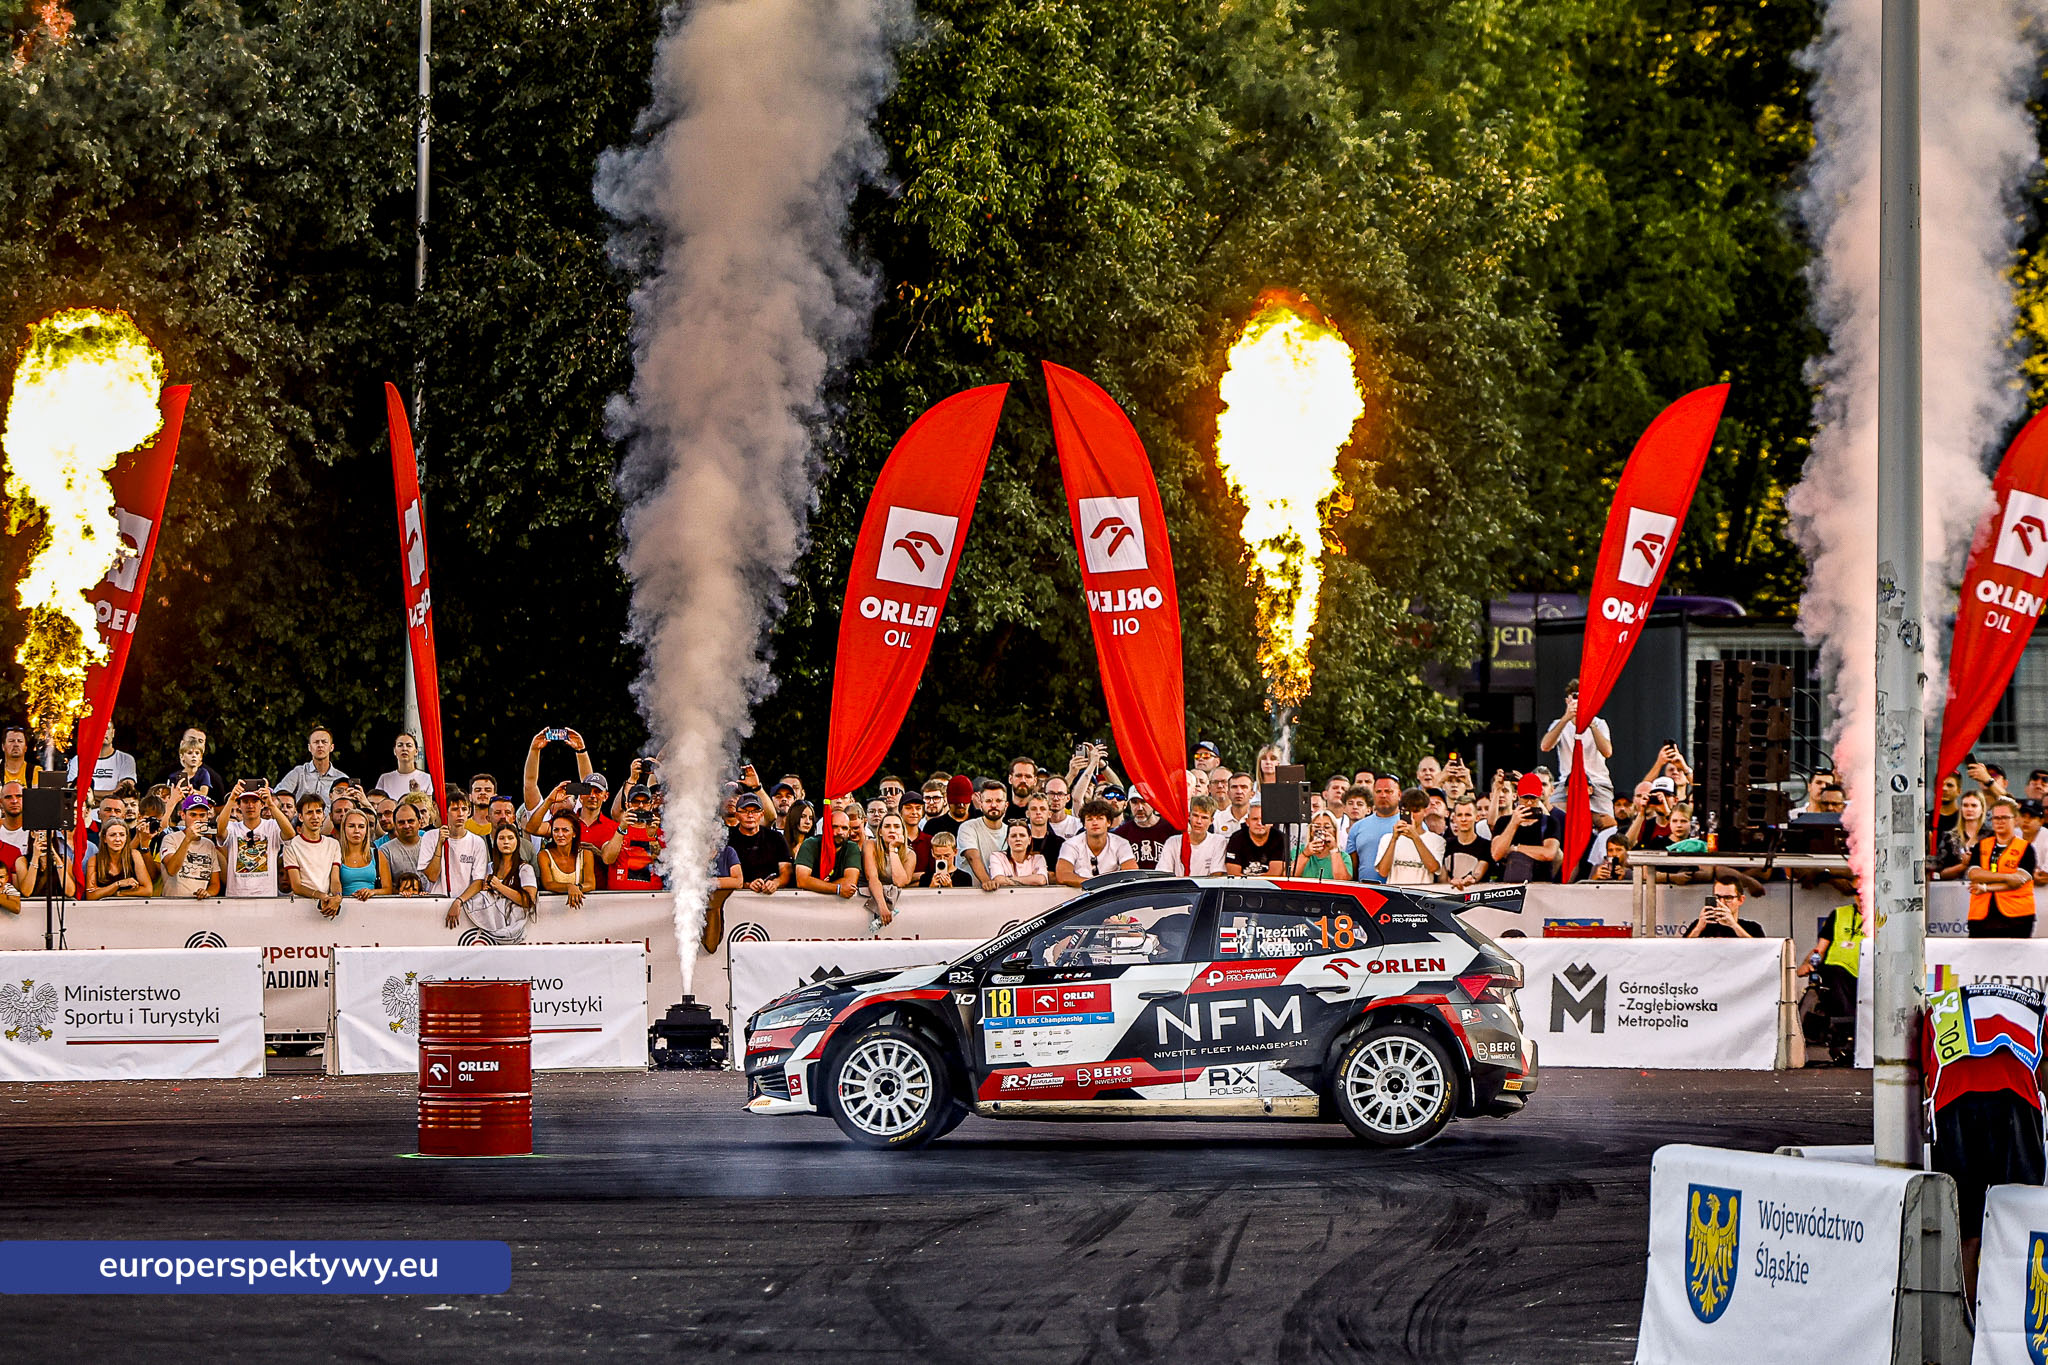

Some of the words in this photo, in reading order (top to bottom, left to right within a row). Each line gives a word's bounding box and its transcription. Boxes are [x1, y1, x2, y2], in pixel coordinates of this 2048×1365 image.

[1976, 579, 2043, 618] ORLEN
[860, 596, 938, 628] ORLEN
[1984, 611, 2011, 633] OIL
[884, 629, 912, 648] OIL
[1484, 889, 1522, 899] SKODA
[984, 918, 1046, 957] rzeznikadrian
[1239, 929, 1251, 938] A.
[1256, 925, 1308, 938] Rzeźnik
[1314, 915, 1355, 949] 18
[1239, 942, 1253, 953] K.
[1257, 939, 1313, 953] Kozdroń
[1367, 958, 1446, 975] ORLEN
[1226, 972, 1278, 982] PRO-FAMILIA
[64, 985, 181, 1002] Ministerstwo
[1063, 991, 1095, 1000] ORLEN
[1619, 981, 1699, 998] Górnośląsko
[531, 996, 603, 1014] urystyki
[988, 989, 1012, 1018] 18
[1619, 998, 1718, 1014] -Zagłębiowska
[64, 1009, 123, 1028] Sportu
[129, 1008, 133, 1024] i
[139, 1007, 220, 1027] Turystyki
[1040, 1016, 1083, 1024] Championship
[1156, 995, 1303, 1045] NFM
[1618, 1014, 1689, 1031] Metropolia
[1154, 1049, 1197, 1059] NIVETTE
[1200, 1046, 1232, 1055] FLEET
[1236, 1039, 1309, 1052] MANAGEMENT
[1489, 1041, 1516, 1052] BERG
[458, 1061, 500, 1072] ORLEN
[1093, 1065, 1132, 1078] BERG
[458, 1073, 475, 1082] OIL
[1208, 1066, 1256, 1087] RX
[1209, 1085, 1258, 1096] POLSKA
[1758, 1200, 1864, 1243] Województwo
[1754, 1241, 1809, 1288] Śląskie
